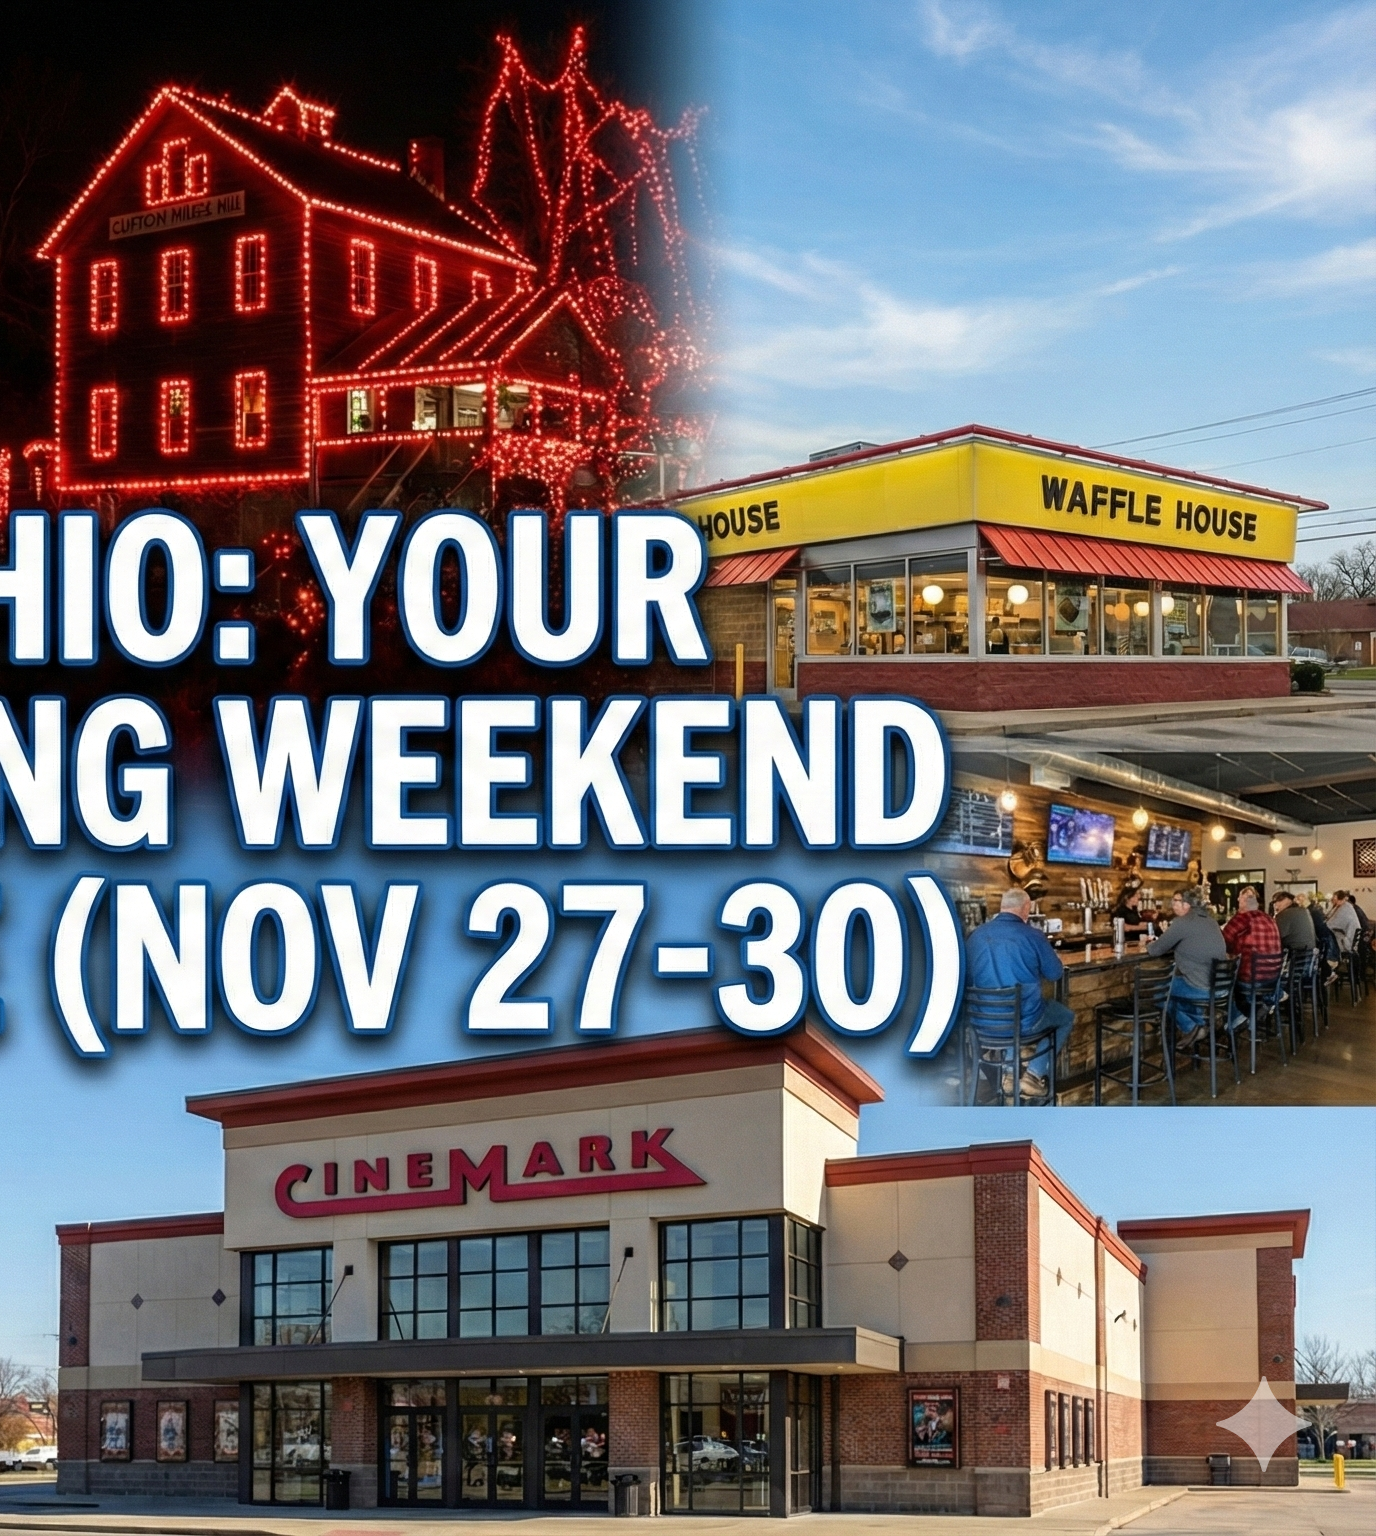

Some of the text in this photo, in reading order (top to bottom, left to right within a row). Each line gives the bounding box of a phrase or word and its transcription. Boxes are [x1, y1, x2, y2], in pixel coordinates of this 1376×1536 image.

[697, 499, 781, 542] HOUSE
[1041, 474, 1258, 542] WAFFLE HOUSE
[275, 1128, 707, 1219] CINEMARK
